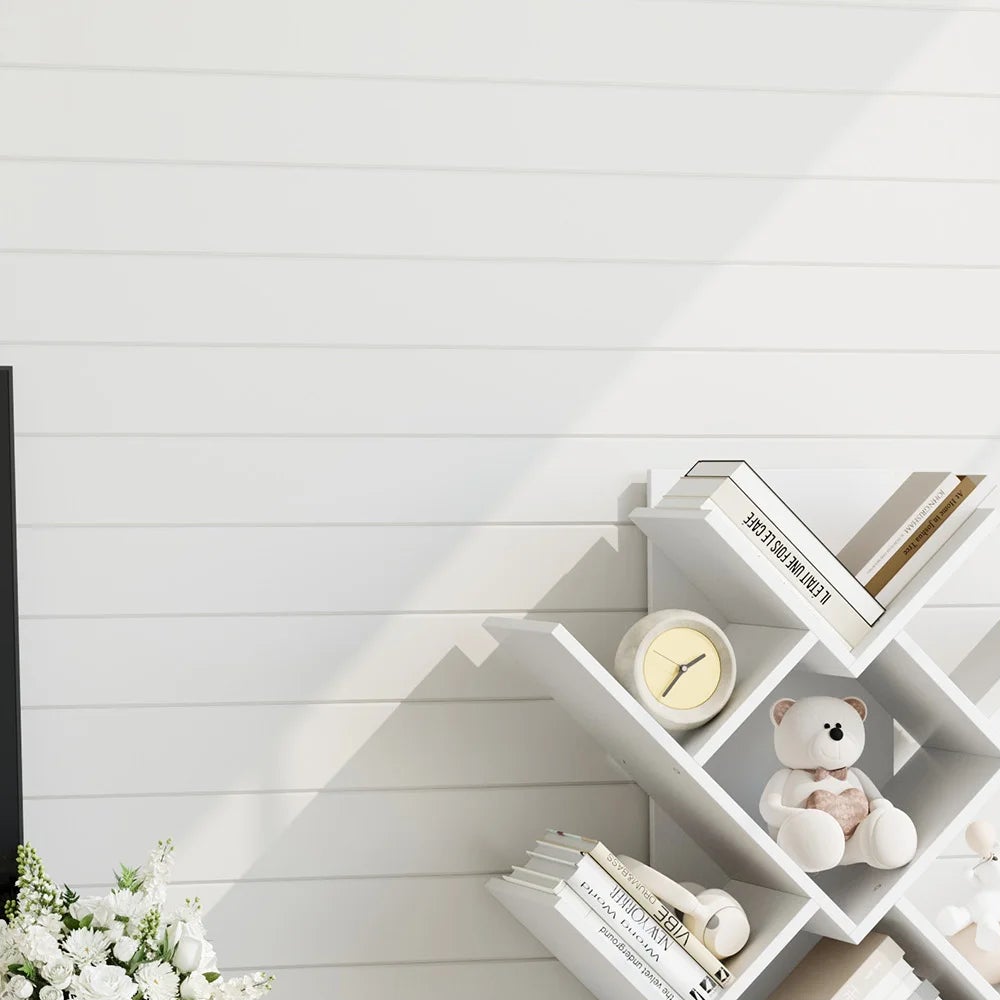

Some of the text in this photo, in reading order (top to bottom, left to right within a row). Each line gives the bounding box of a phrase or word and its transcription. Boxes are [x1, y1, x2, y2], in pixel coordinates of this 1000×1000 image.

[741, 511, 831, 605] IL ÉTAIT UNE FOIS LE CAFÉ
[902, 489, 962, 556] At Home in Joshua Tree
[580, 881, 659, 962] Wrong World
[606, 854, 689, 946] VIBE DRUM&BASS
[599, 927, 643, 968] underground
[641, 967, 662, 988] velvet
